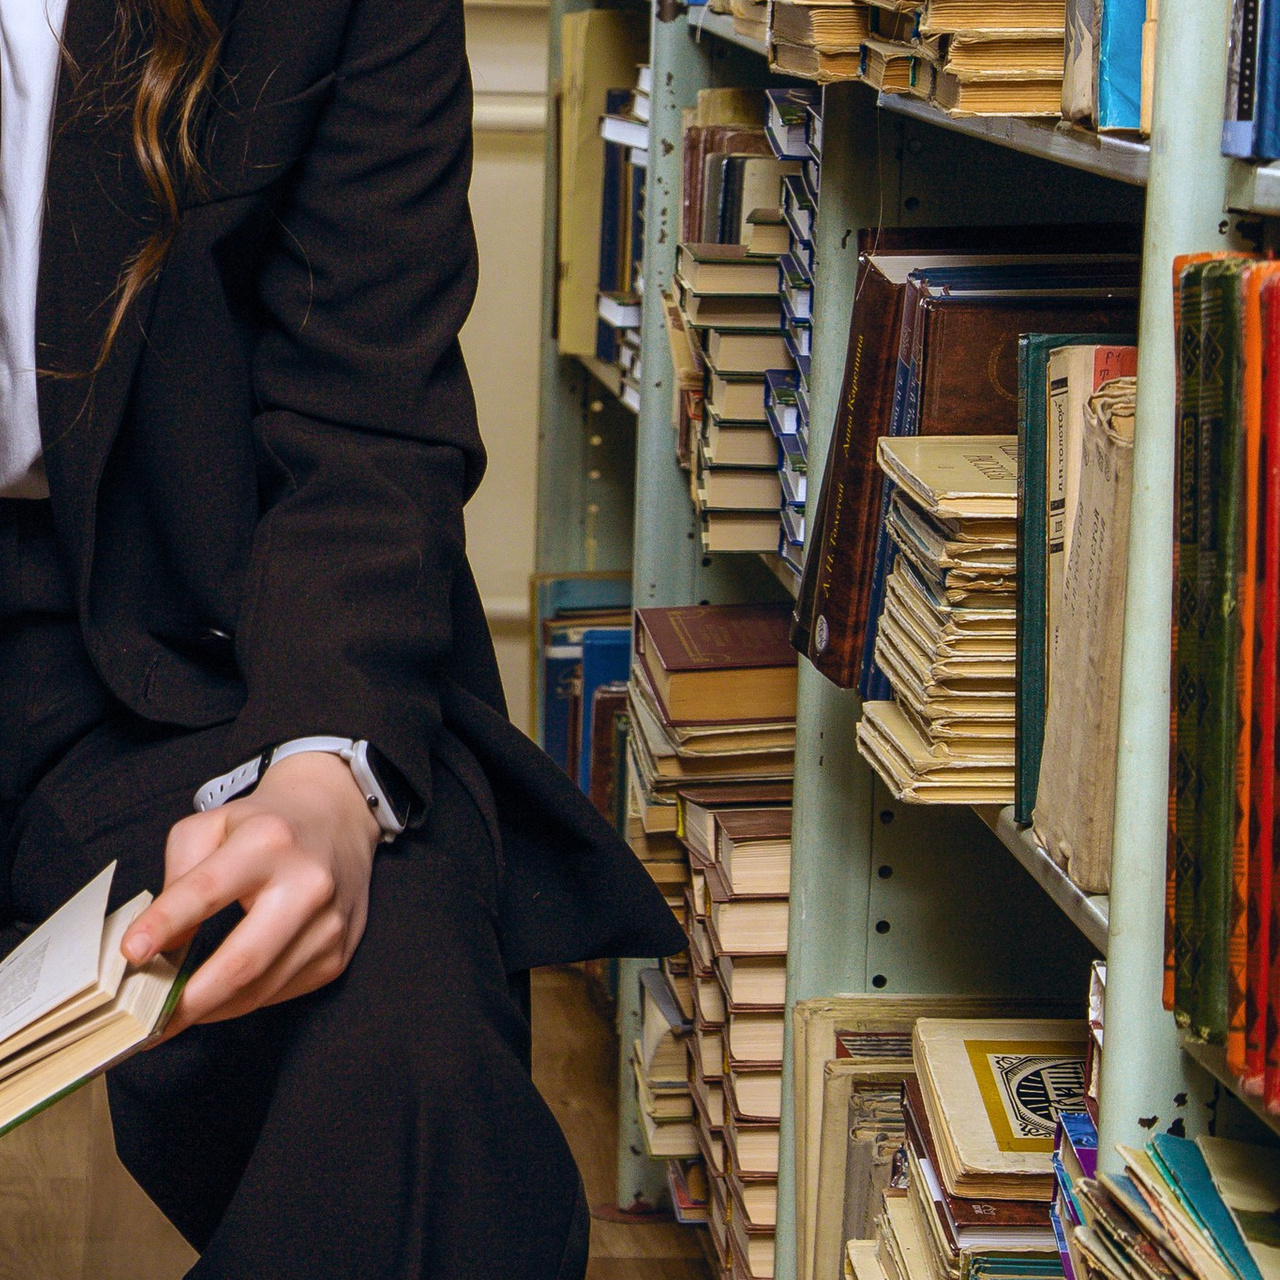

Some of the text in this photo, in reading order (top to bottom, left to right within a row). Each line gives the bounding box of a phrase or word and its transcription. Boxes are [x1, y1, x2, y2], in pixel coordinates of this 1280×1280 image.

[846, 334, 864, 411] Каренина
[841, 415, 853, 459] Анна
[828, 482, 844, 548] Толстой
